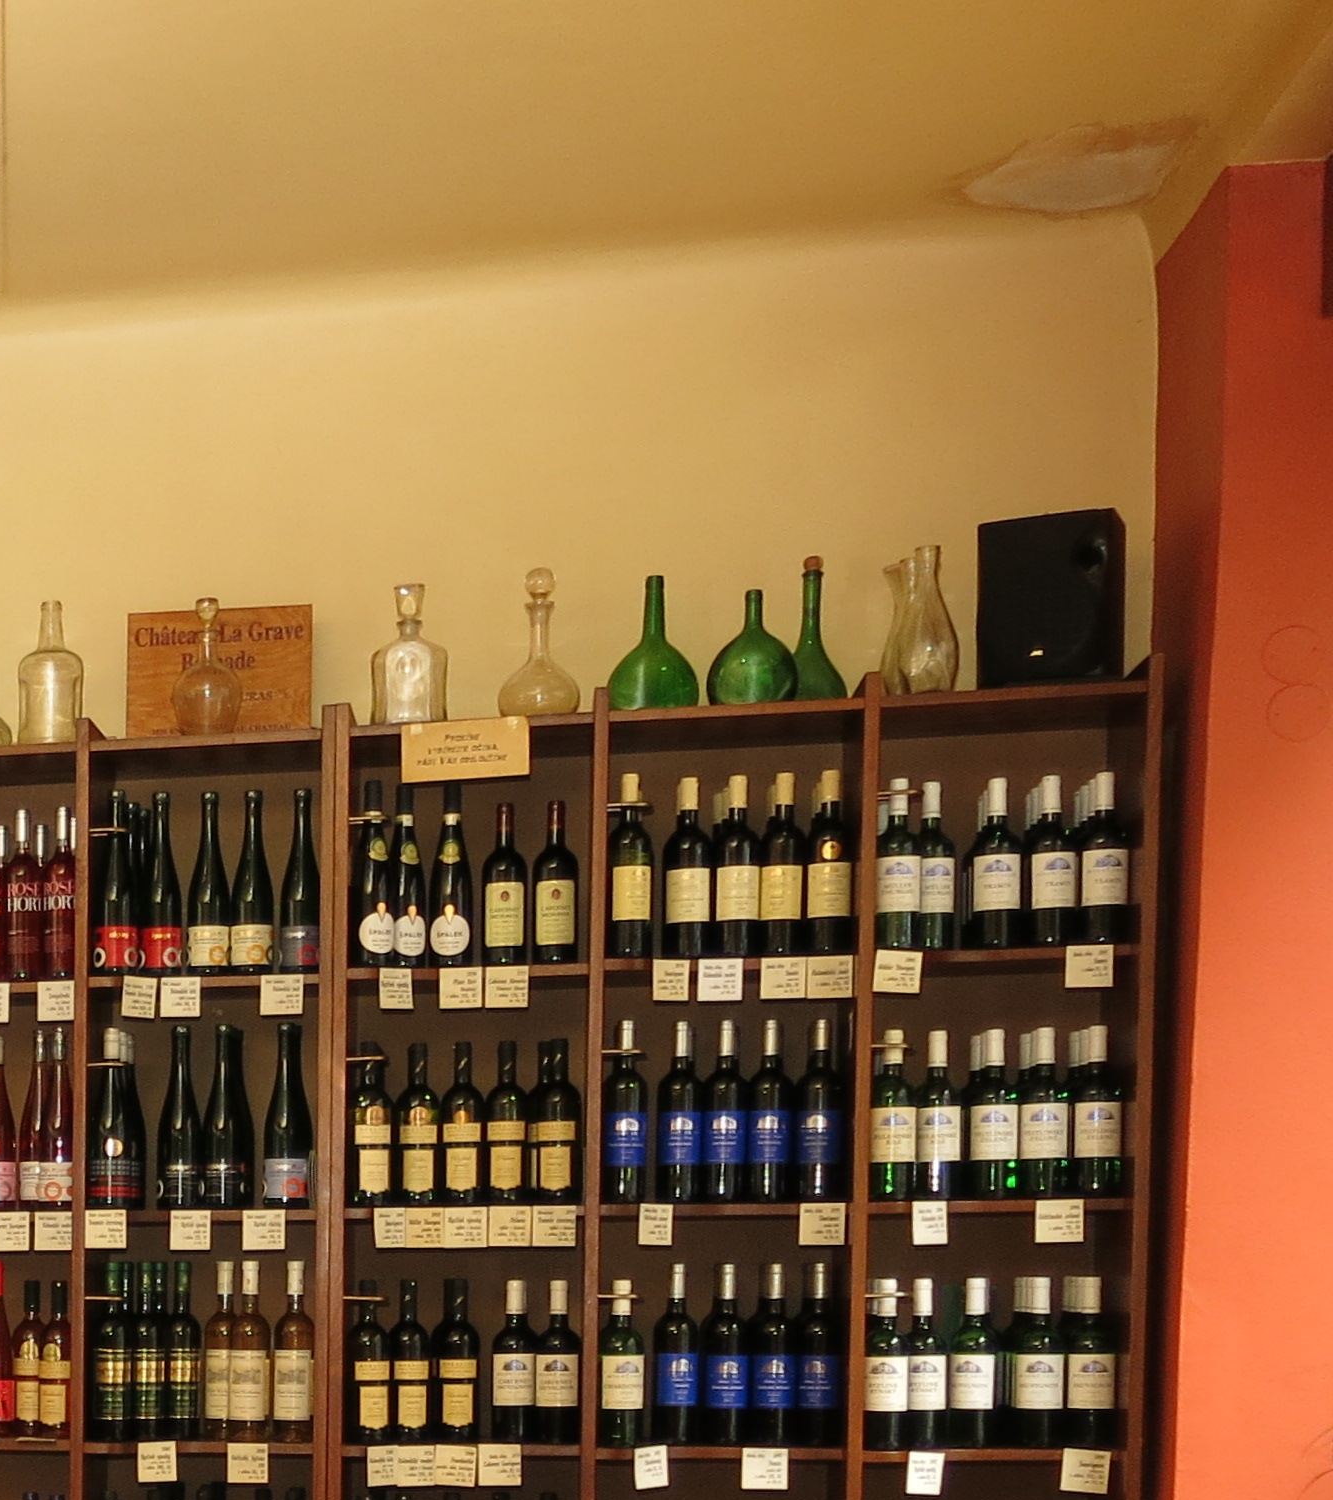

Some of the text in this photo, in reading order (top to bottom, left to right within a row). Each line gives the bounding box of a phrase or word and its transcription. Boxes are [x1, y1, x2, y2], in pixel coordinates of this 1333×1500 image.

[134, 621, 305, 648] Châtea La Grave
